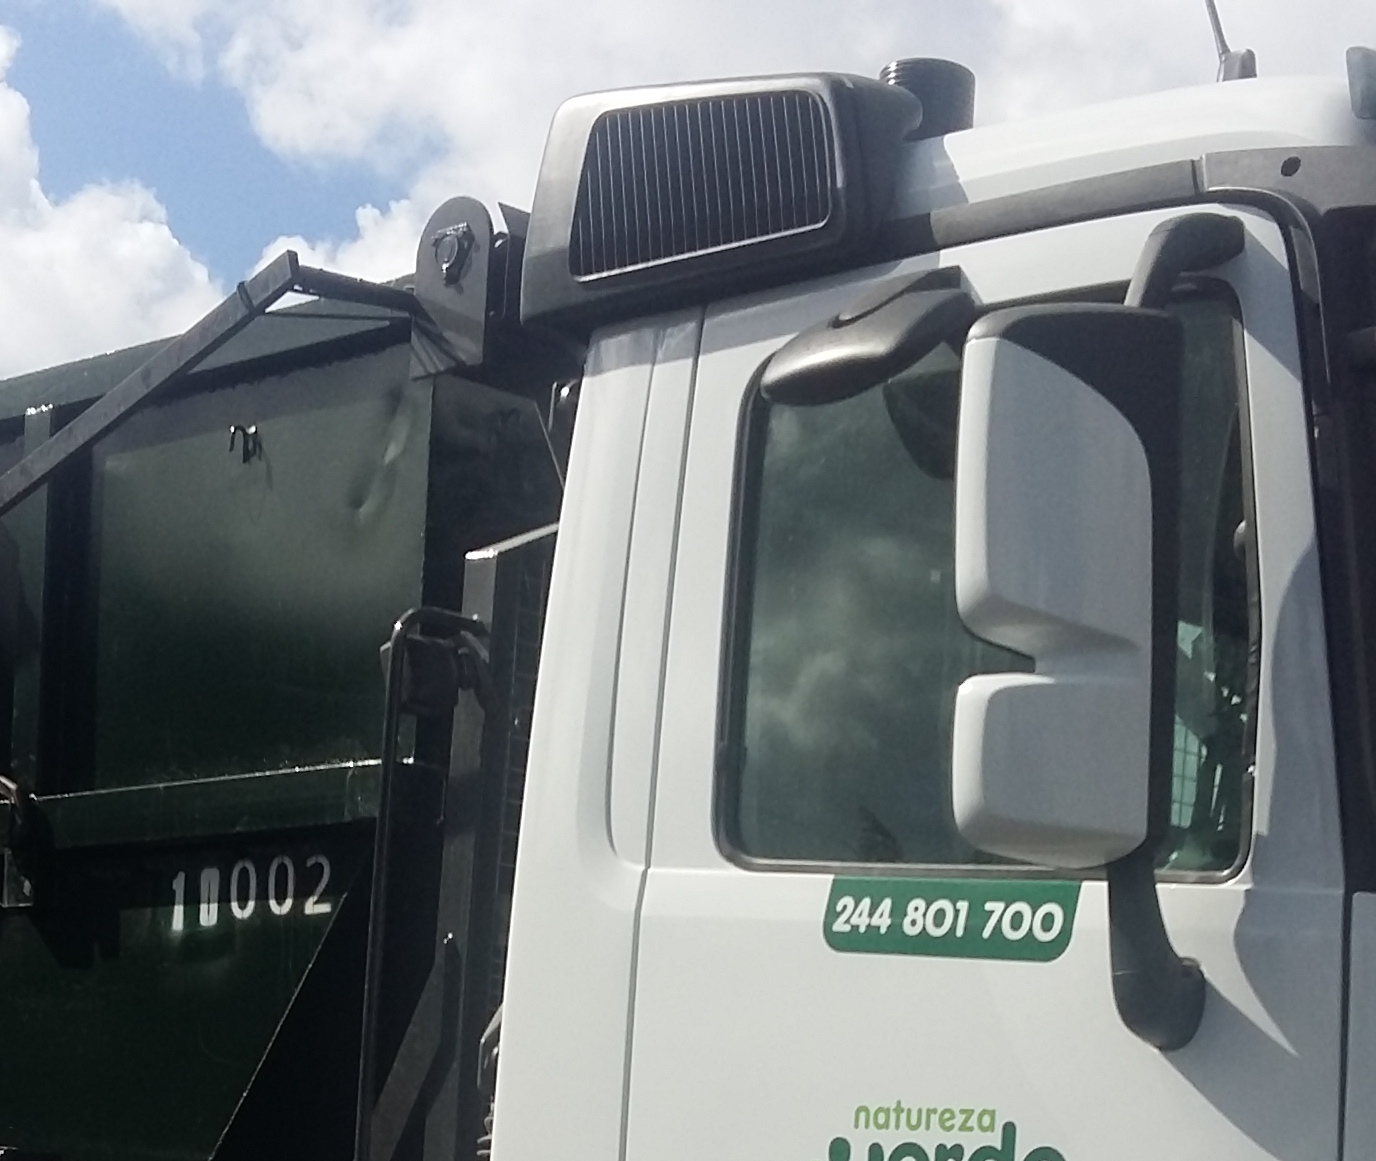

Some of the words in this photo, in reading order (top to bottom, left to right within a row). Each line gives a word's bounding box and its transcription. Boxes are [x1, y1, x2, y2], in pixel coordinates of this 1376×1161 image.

[172, 854, 332, 931] 10002
[831, 895, 892, 935] 244
[902, 897, 969, 938] 801
[981, 901, 1065, 943] 700
[853, 1100, 997, 1134] natureza
